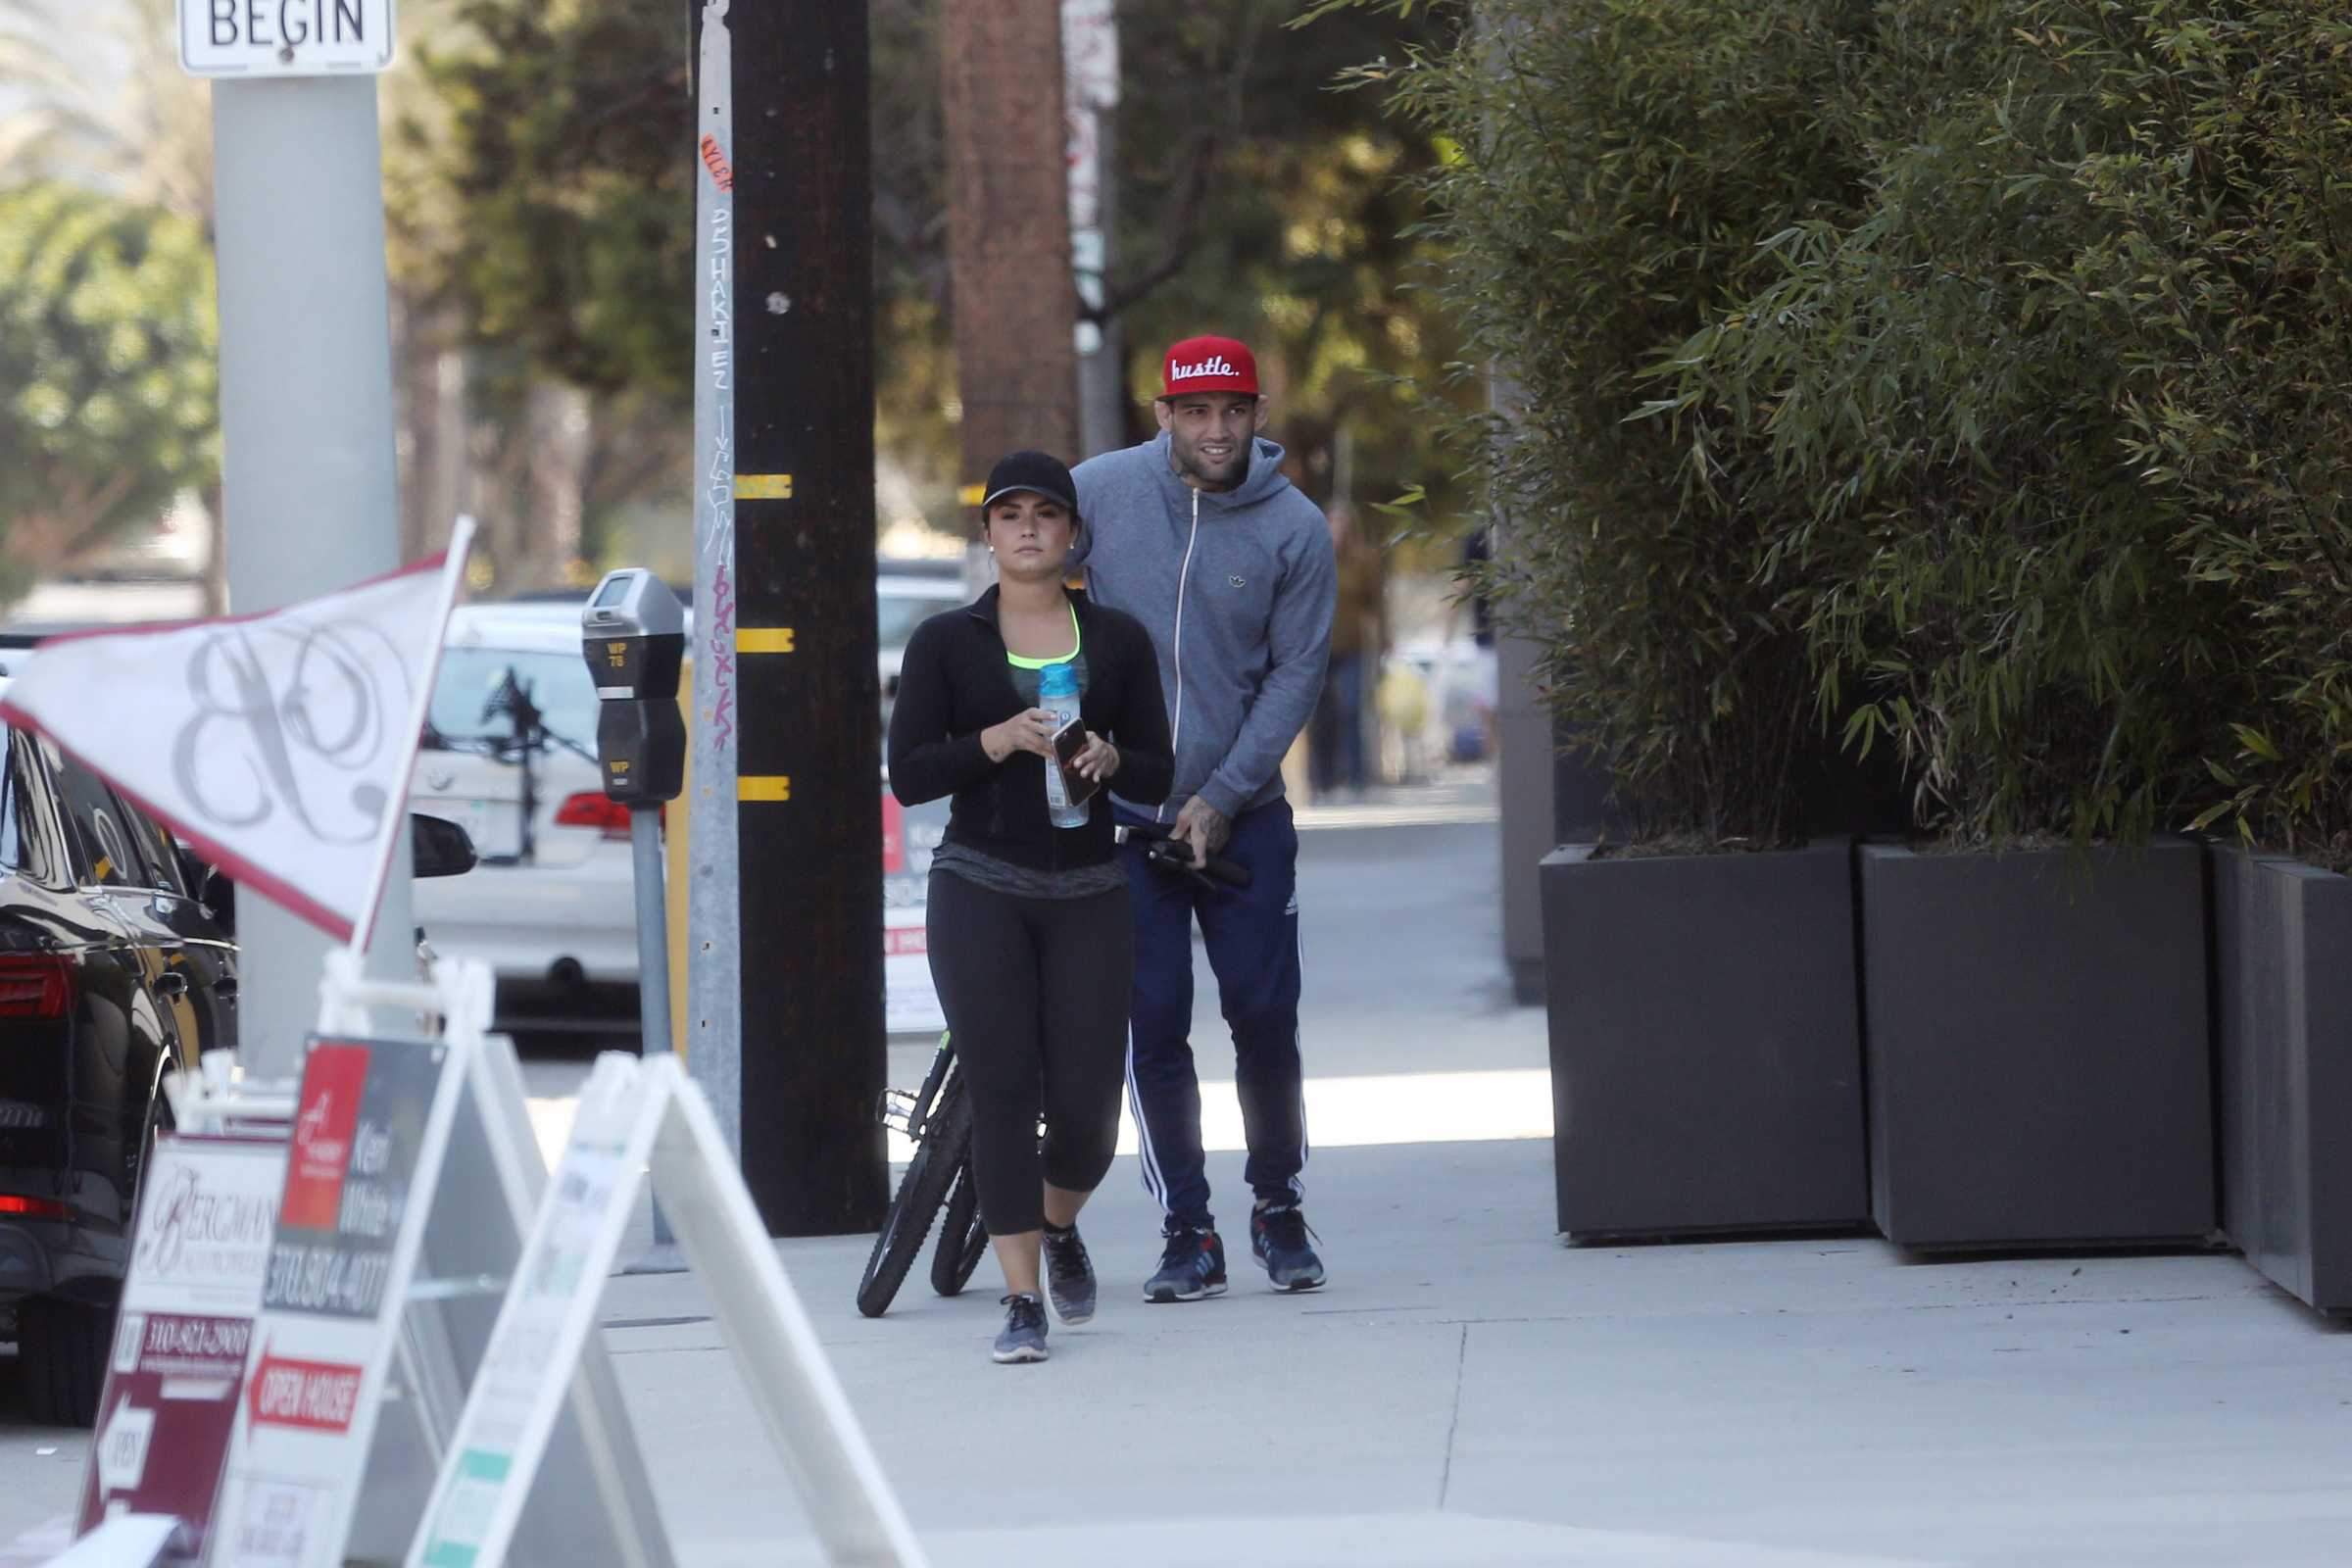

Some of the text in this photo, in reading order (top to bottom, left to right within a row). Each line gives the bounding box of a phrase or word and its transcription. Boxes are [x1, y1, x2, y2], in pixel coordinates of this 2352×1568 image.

[210, 0, 364, 46] BEGIN
[1171, 356, 1240, 381] hustle.
[608, 643, 626, 654] WP
[611, 761, 629, 772] WP
[260, 1366, 359, 1424] OPEN HOUSE
